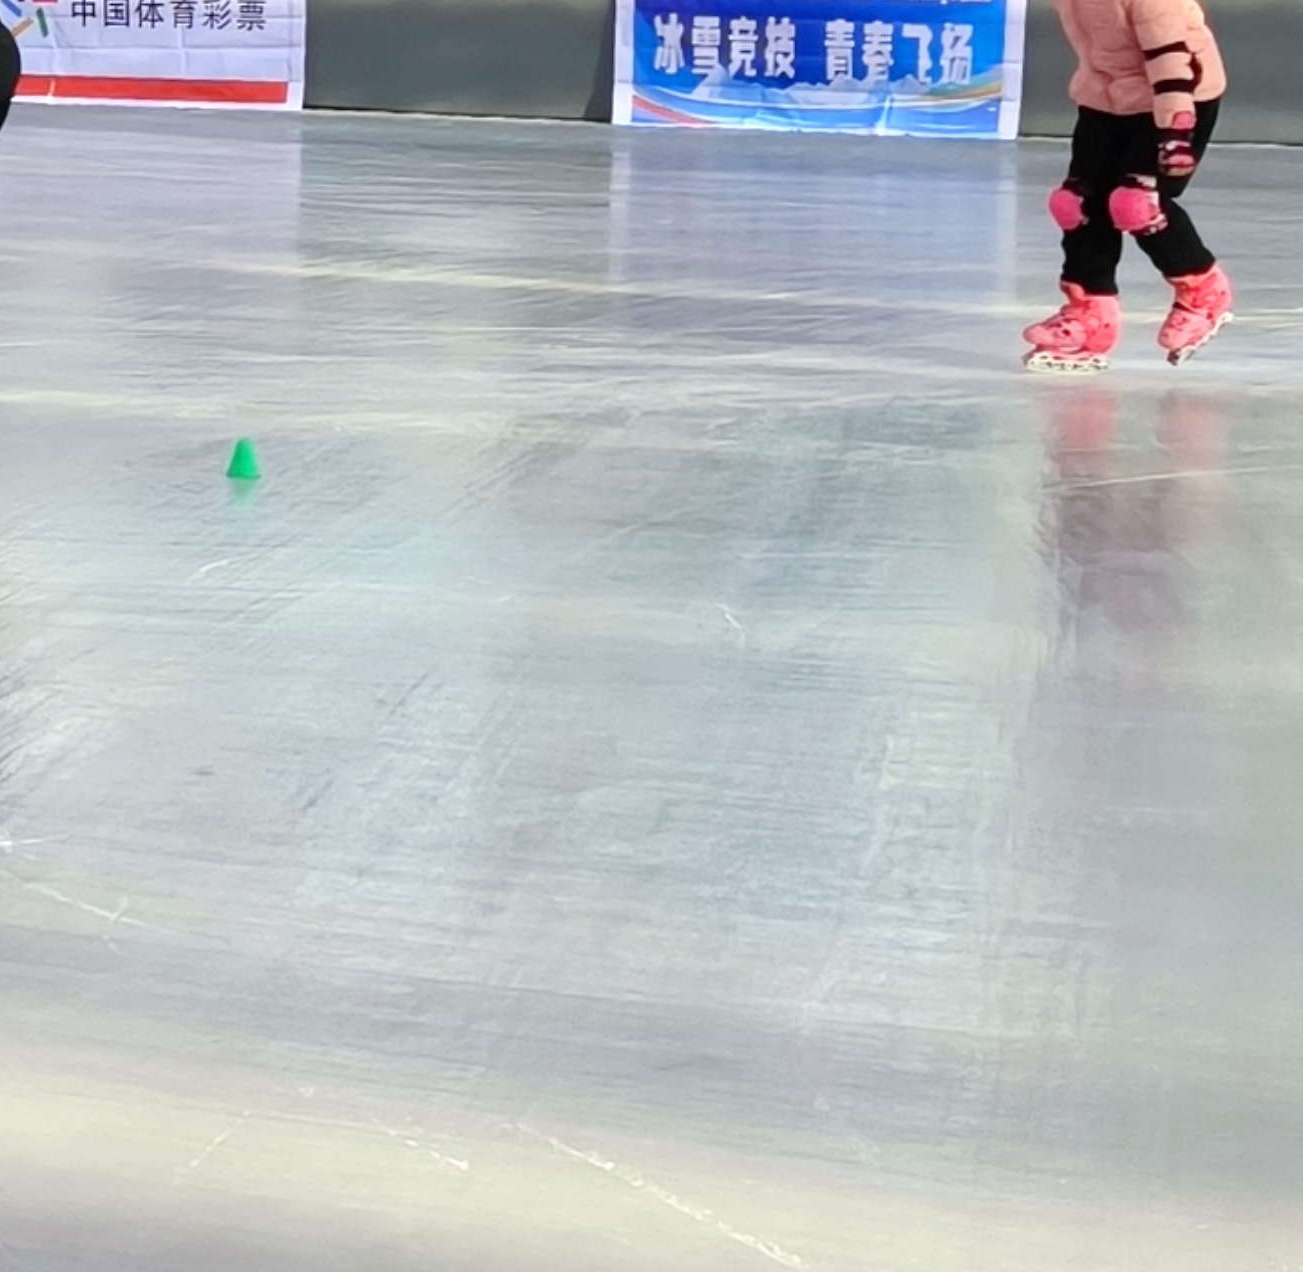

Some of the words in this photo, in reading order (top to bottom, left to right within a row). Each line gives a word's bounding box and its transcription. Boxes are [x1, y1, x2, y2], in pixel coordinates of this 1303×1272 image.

[653, 12, 796, 79] 冰雪竞技
[824, 18, 974, 85] 青春飞扬
